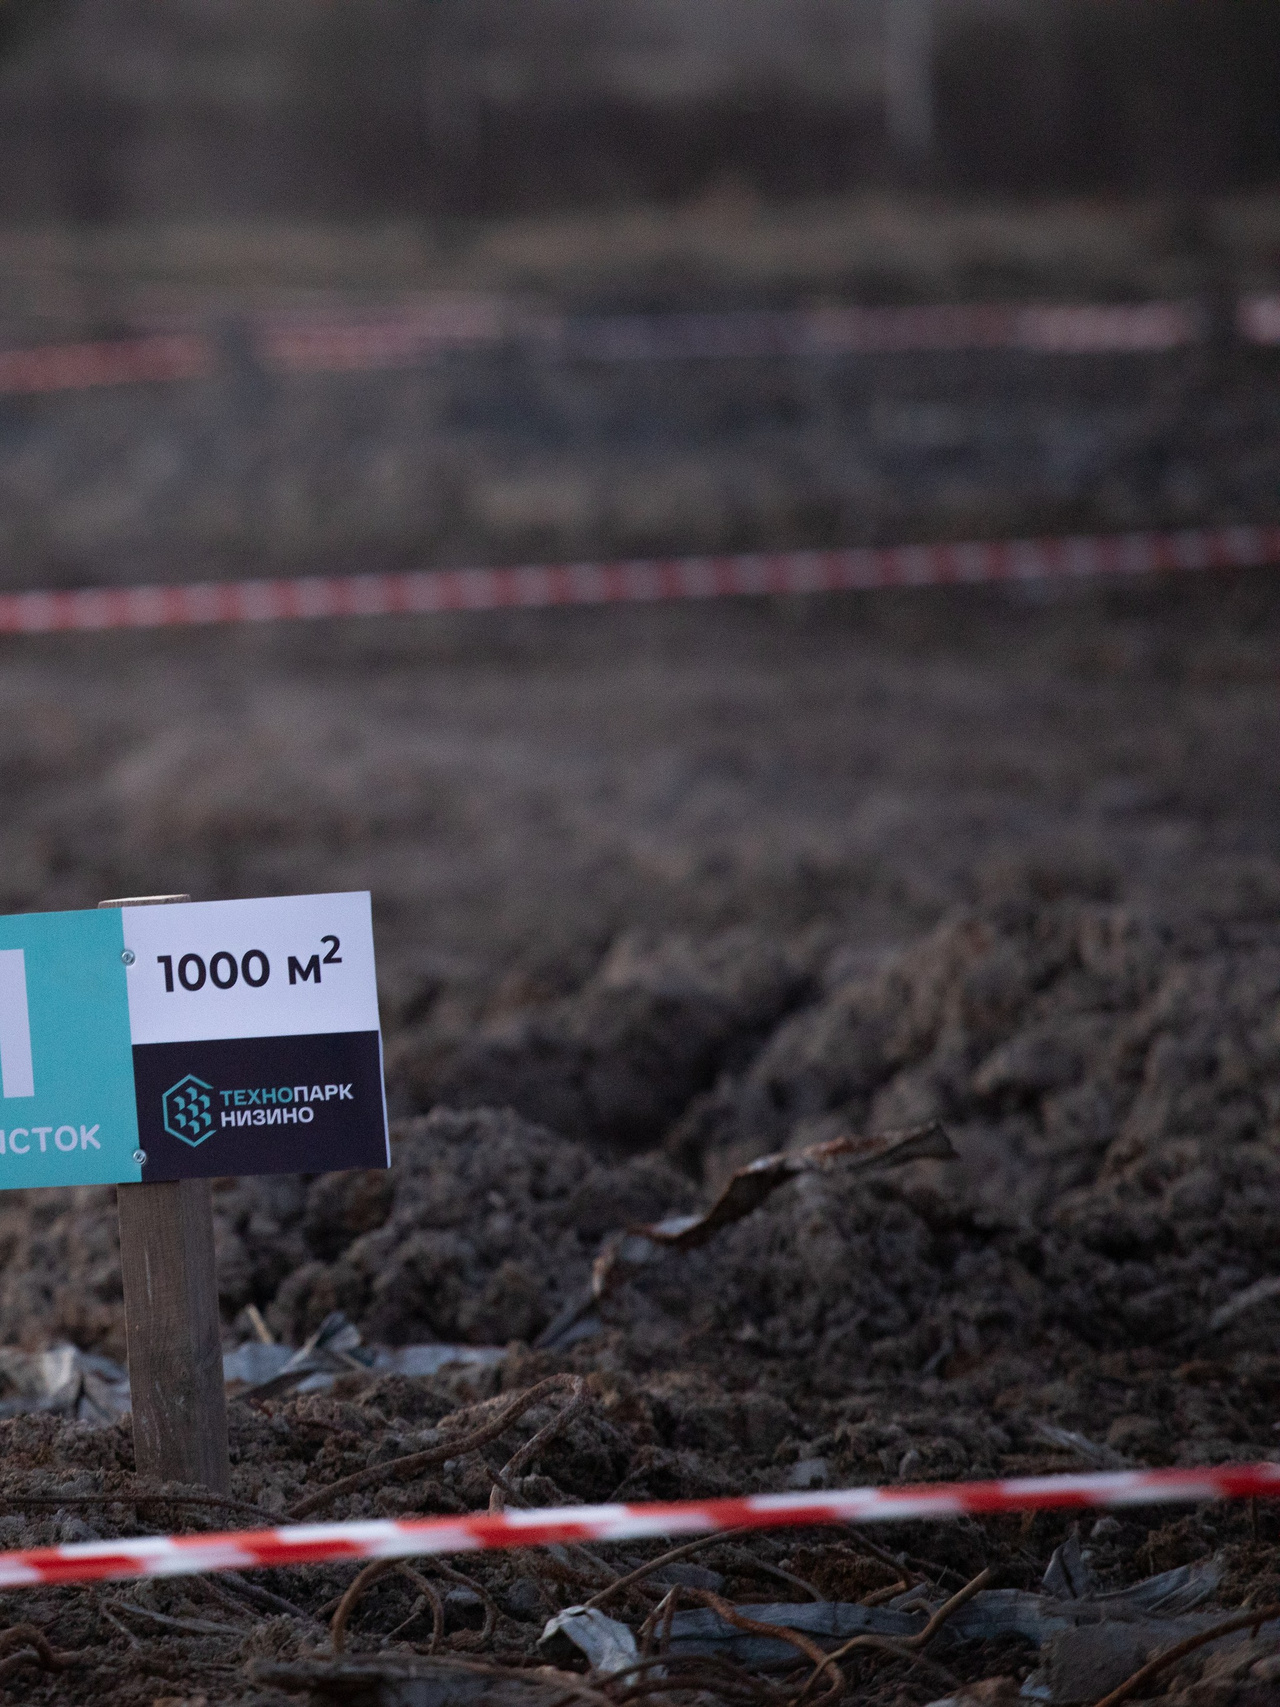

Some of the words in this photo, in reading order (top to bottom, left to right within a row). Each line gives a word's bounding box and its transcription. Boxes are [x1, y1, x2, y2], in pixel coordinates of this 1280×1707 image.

[157, 949, 270, 993] 1000
[219, 1083, 354, 1108] ТЕХНОПАРК
[220, 1106, 315, 1128] НИЗИНО
